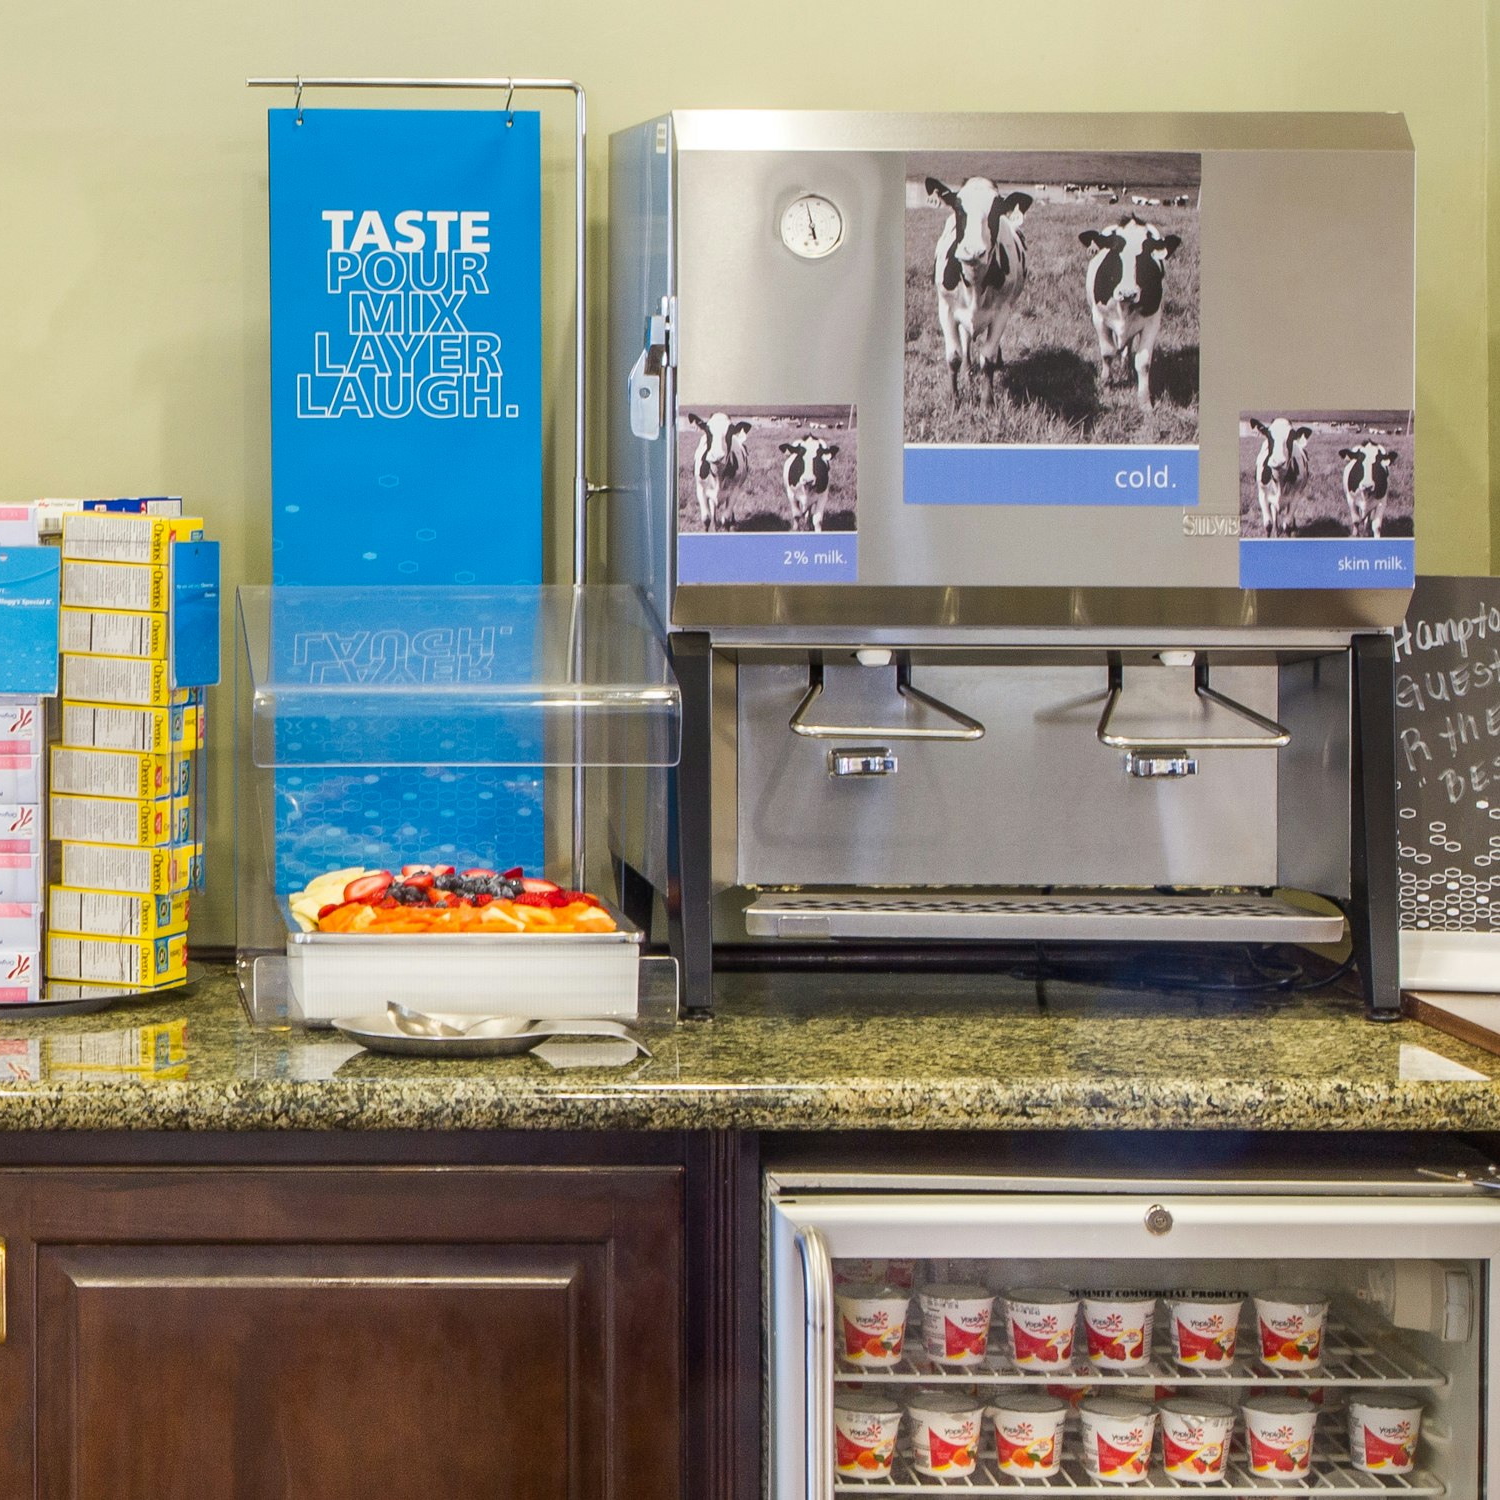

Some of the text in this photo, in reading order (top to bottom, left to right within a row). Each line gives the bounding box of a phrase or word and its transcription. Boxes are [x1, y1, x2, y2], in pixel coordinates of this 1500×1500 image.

[321, 210, 491, 252] TASTE
[327, 249, 490, 294] POUR
[349, 291, 468, 335] MIX
[315, 332, 503, 376] LAYER
[297, 373, 519, 418] LAUGH.
[1115, 464, 1177, 489] cold.
[153, 523, 165, 561] Cheerios
[783, 550, 848, 565] 2% milk.
[1338, 556, 1407, 571] skim milk.
[153, 571, 164, 608] Cheerios
[152, 619, 162, 652] Cheerios
[153, 664, 165, 702] Cheerios
[154, 714, 164, 747] Cheerios
[141, 758, 151, 796] Cheerios
[141, 805, 151, 843] Cheerios
[153, 854, 164, 891] Cheerios
[141, 900, 151, 933] Cheerios
[141, 947, 151, 980] Cheerios
[1191, 1289, 1250, 1298] PRODUCTS
